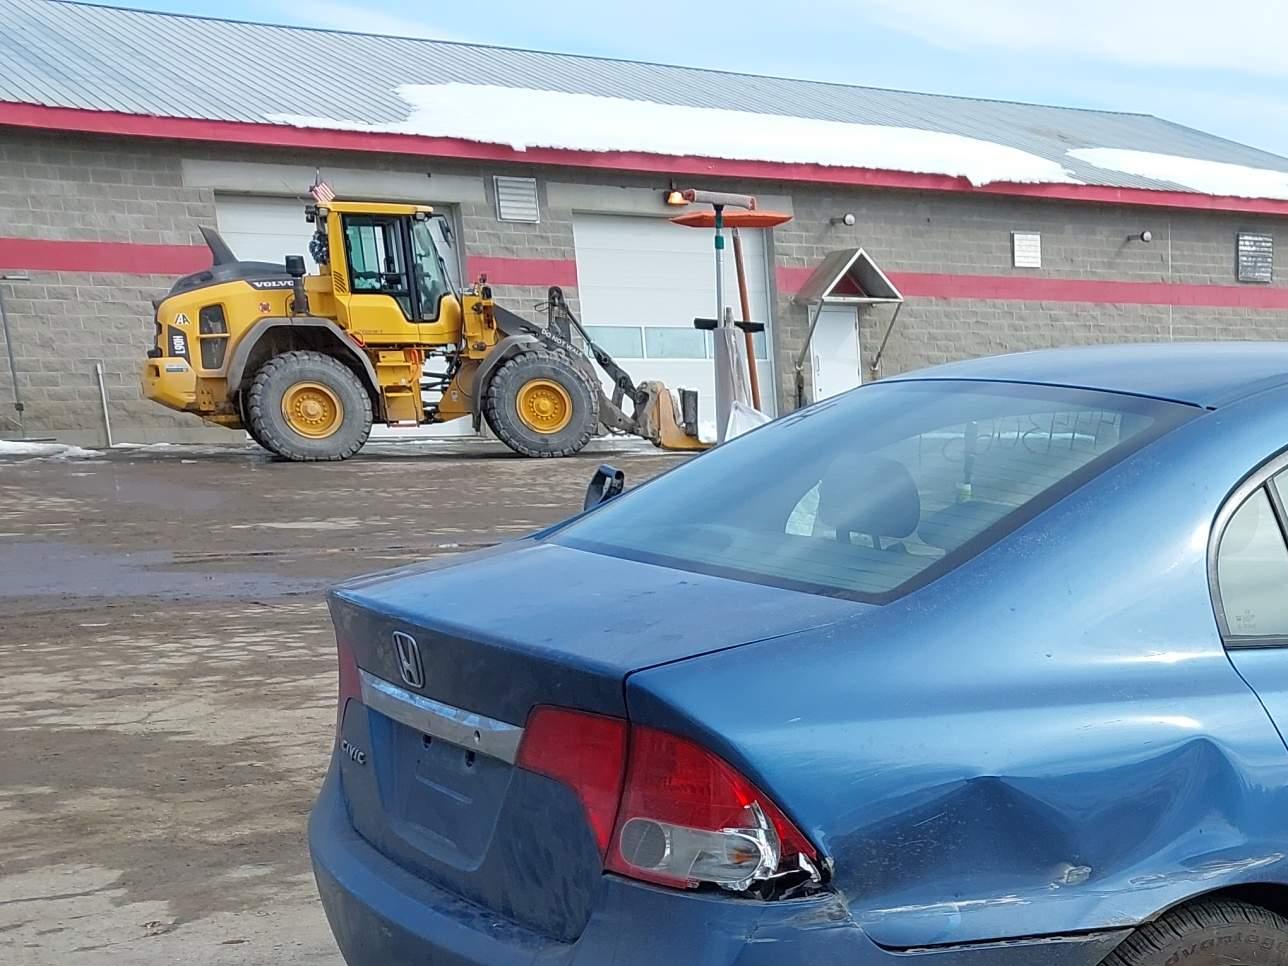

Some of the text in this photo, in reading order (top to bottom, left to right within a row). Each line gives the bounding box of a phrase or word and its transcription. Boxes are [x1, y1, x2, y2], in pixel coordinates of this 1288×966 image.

[253, 280, 295, 288] VOLVO
[541, 328, 552, 338] DO
[552, 335, 566, 346] NOT
[342, 740, 365, 764] CIVIC
